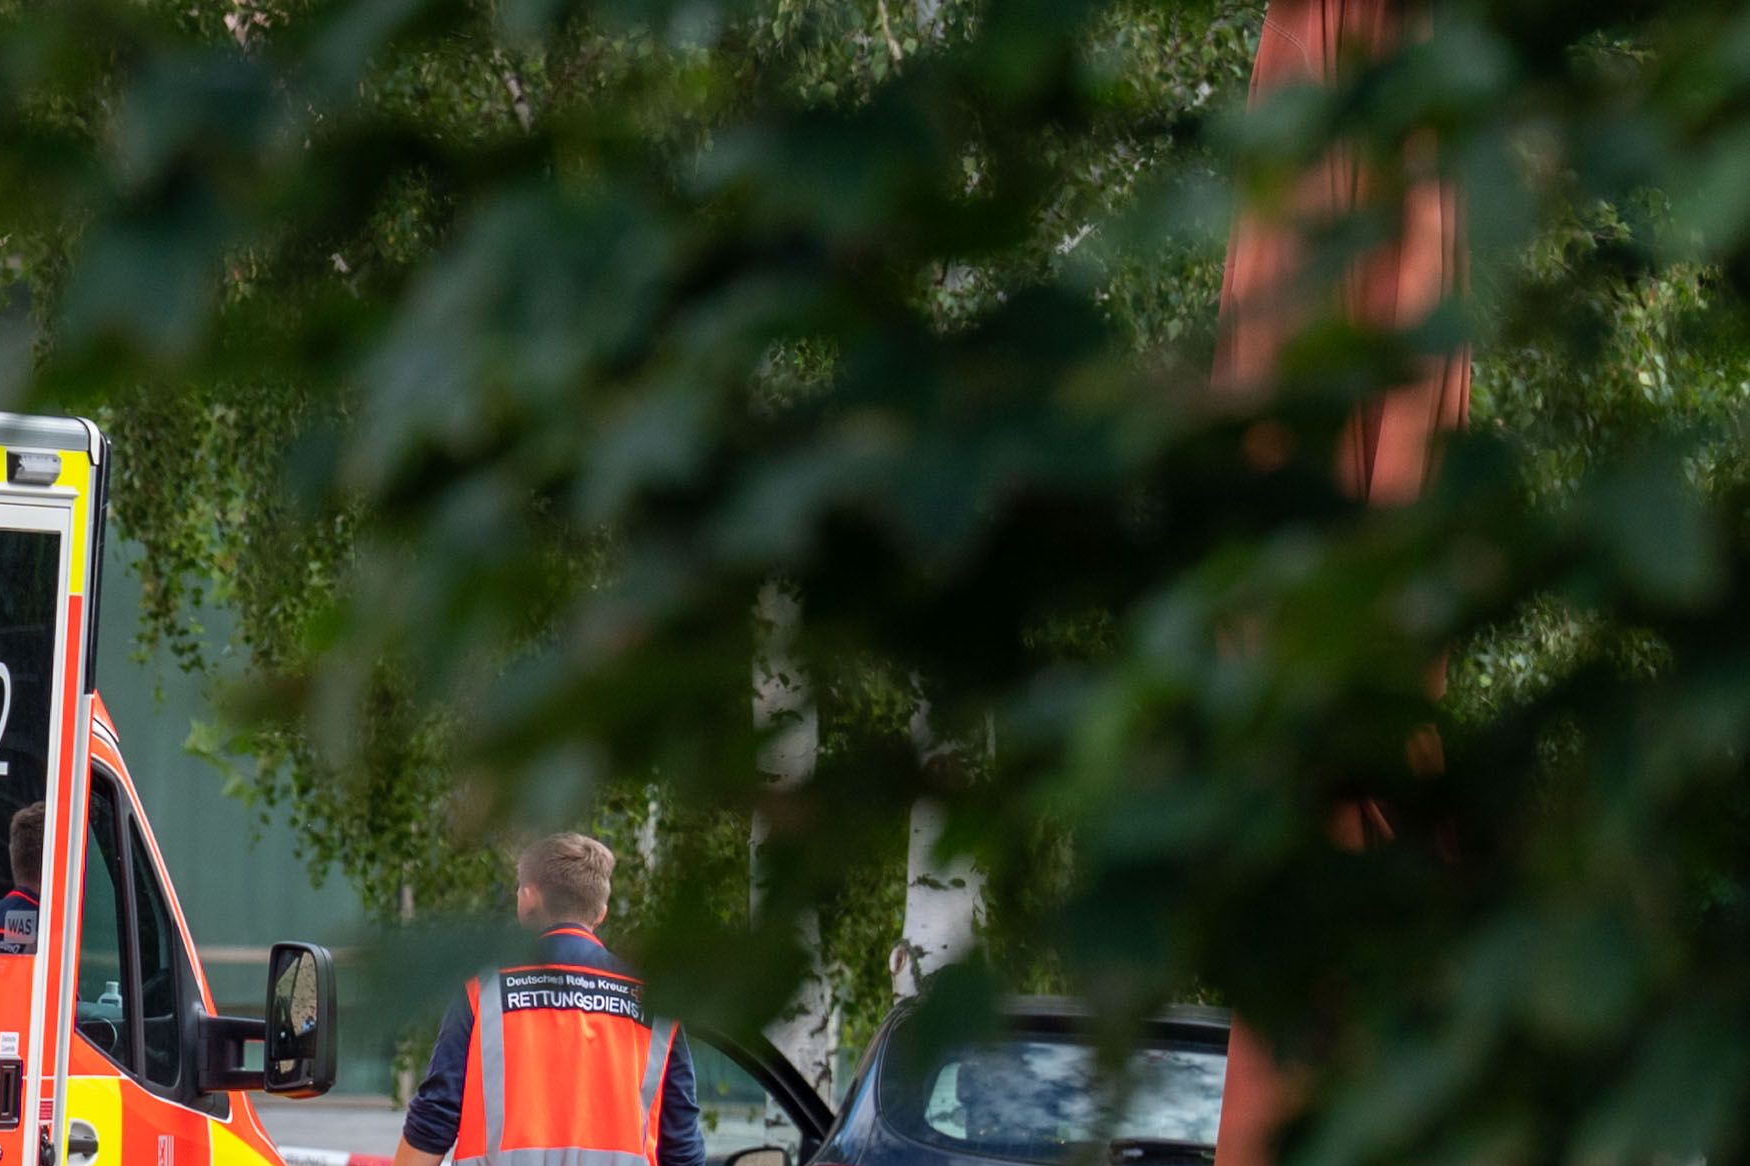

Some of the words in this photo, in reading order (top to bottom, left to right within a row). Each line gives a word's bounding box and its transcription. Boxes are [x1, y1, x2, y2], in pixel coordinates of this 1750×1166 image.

[7, 918, 32, 936] WAS
[506, 974, 563, 987] Deutsches
[597, 978, 629, 994] Kreuz
